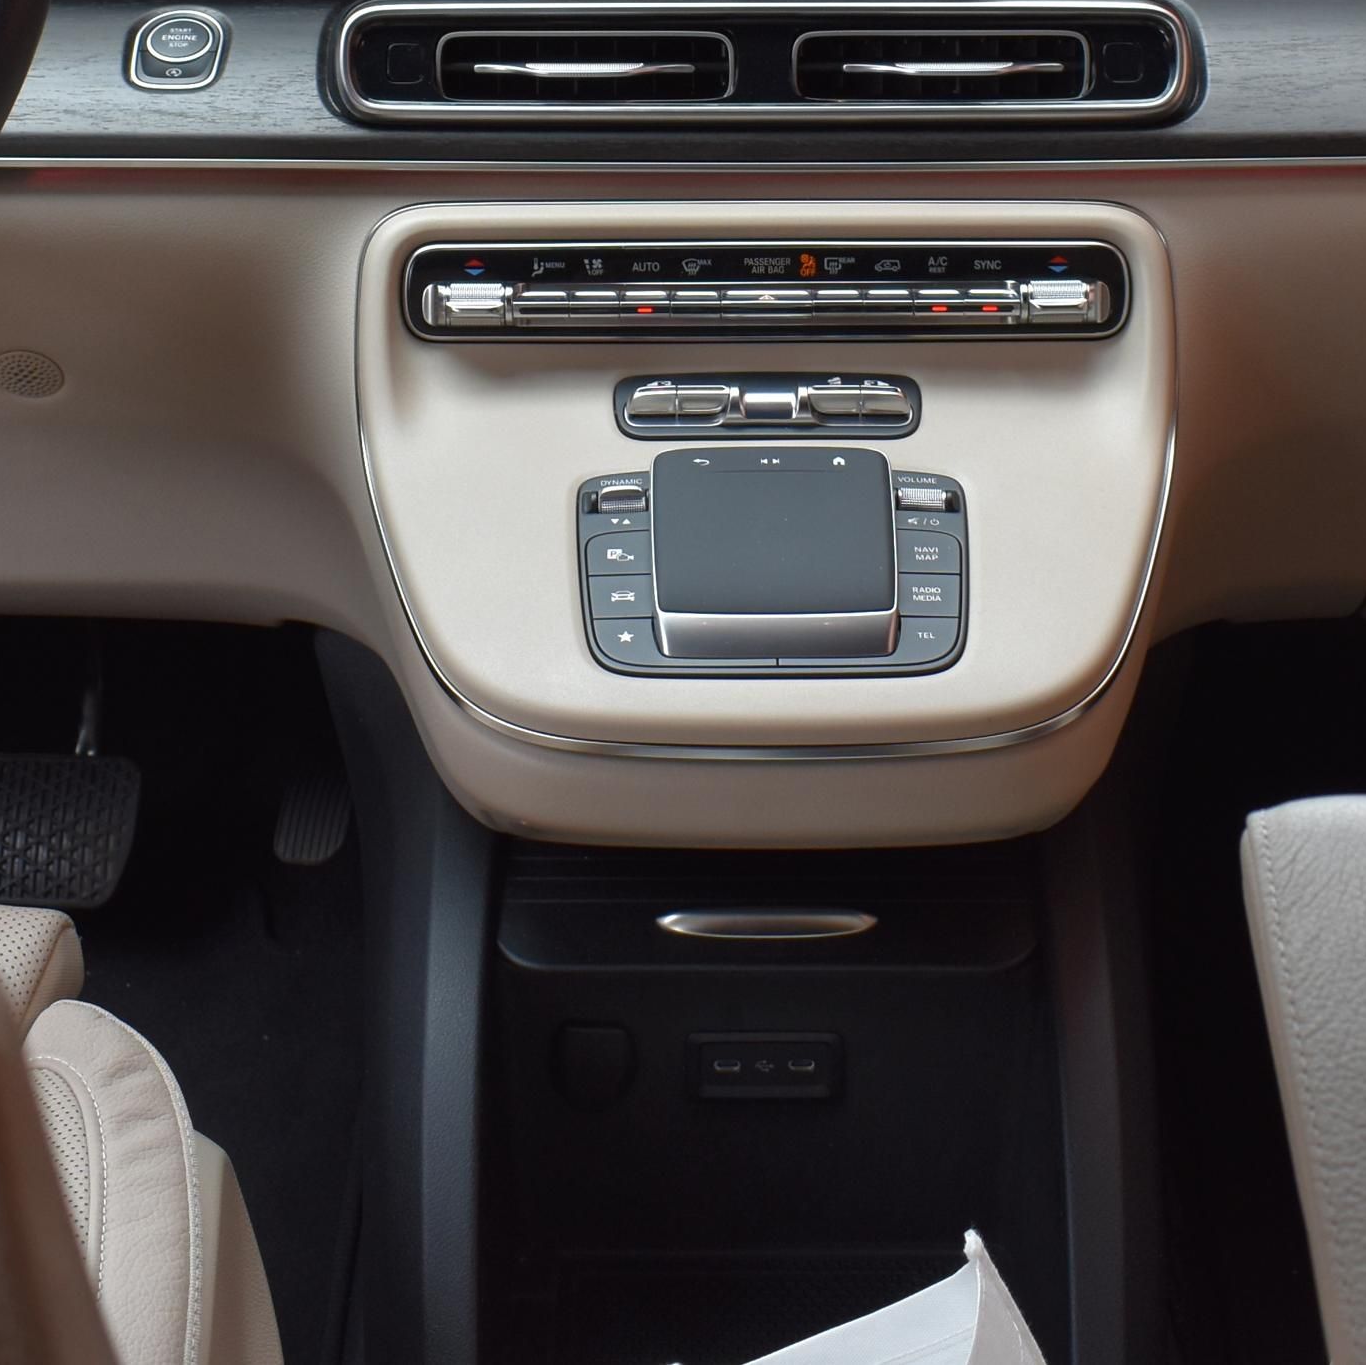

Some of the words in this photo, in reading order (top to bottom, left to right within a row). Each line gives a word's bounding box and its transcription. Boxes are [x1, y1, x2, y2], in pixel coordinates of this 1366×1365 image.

[545, 261, 566, 270] MENU
[744, 257, 791, 266] PASSENGER
[928, 256, 948, 267] A/C
[973, 260, 1002, 270] SYNC
[632, 261, 660, 272] AUTO
[751, 266, 766, 274] AIR
[767, 266, 785, 274] BAG
[600, 478, 643, 487] DYNAMIC
[898, 476, 938, 485] VOLUME
[912, 594, 942, 602] MEDIA
